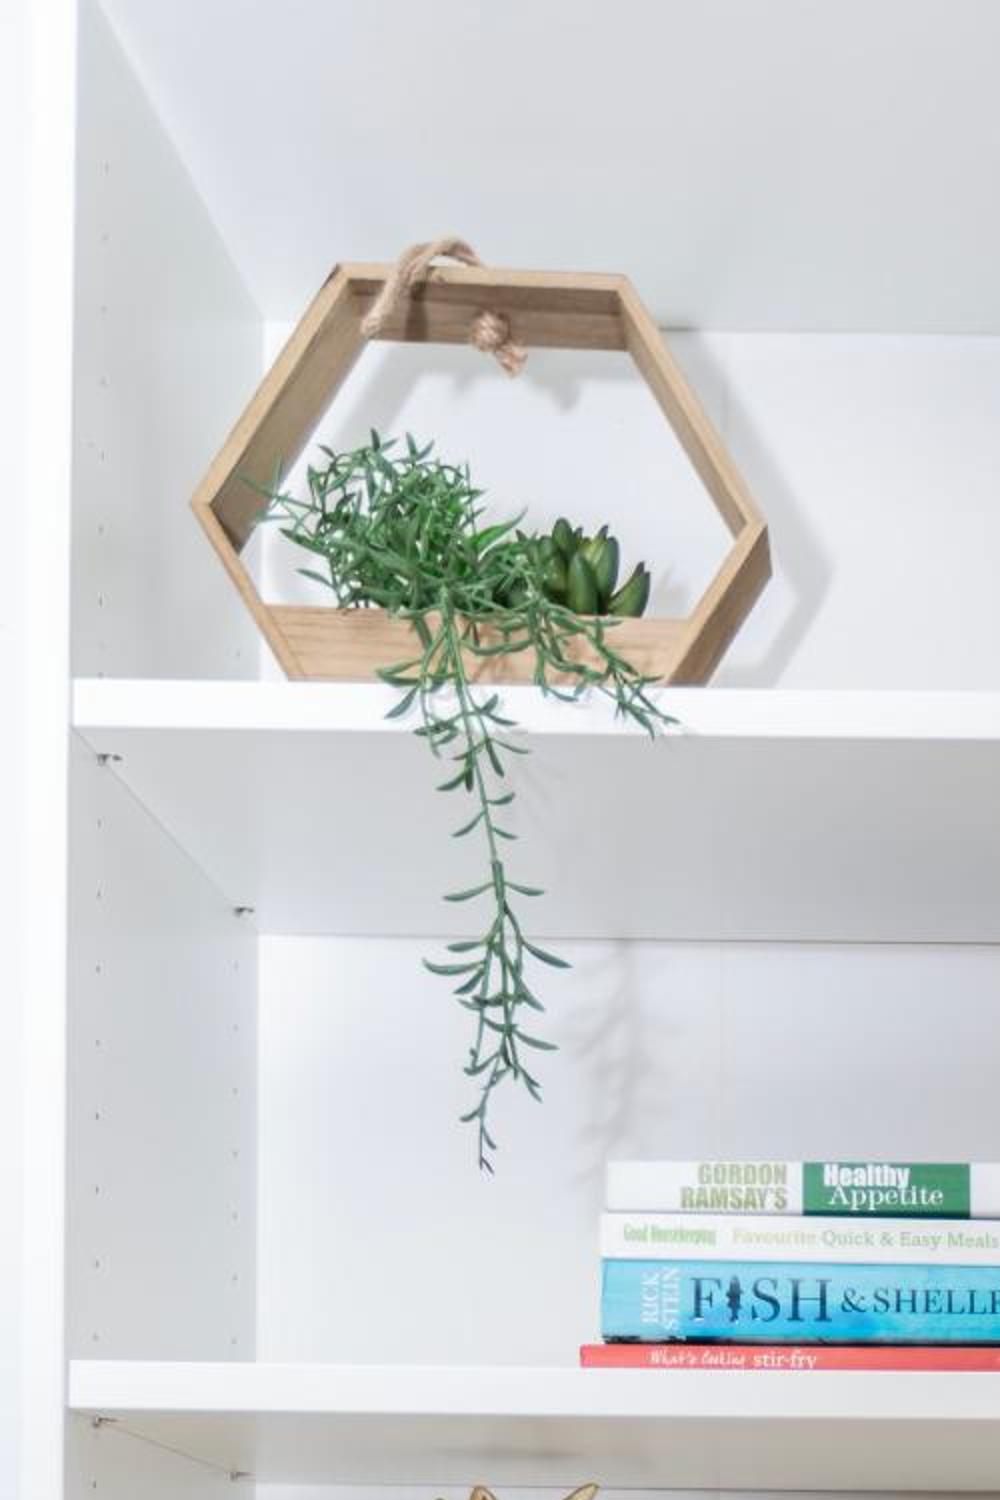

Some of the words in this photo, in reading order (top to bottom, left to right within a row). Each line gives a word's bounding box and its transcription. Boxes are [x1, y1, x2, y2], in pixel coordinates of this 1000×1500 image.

[698, 1163, 788, 1185] GORDON
[823, 1163, 910, 1188] Healthy
[680, 1187, 788, 1209] RAMSAY'S
[828, 1185, 944, 1211] Appetite
[733, 1228, 817, 1245] Favourite
[822, 1230, 876, 1247] Quick
[879, 1232, 894, 1247] &
[899, 1231, 943, 1250] Easy
[946, 1232, 999, 1249] Meals
[641, 1272, 660, 1323] RICK
[662, 1267, 682, 1331] STEIN
[840, 1287, 867, 1313] &
[753, 1350, 817, 1368] stir-fry
